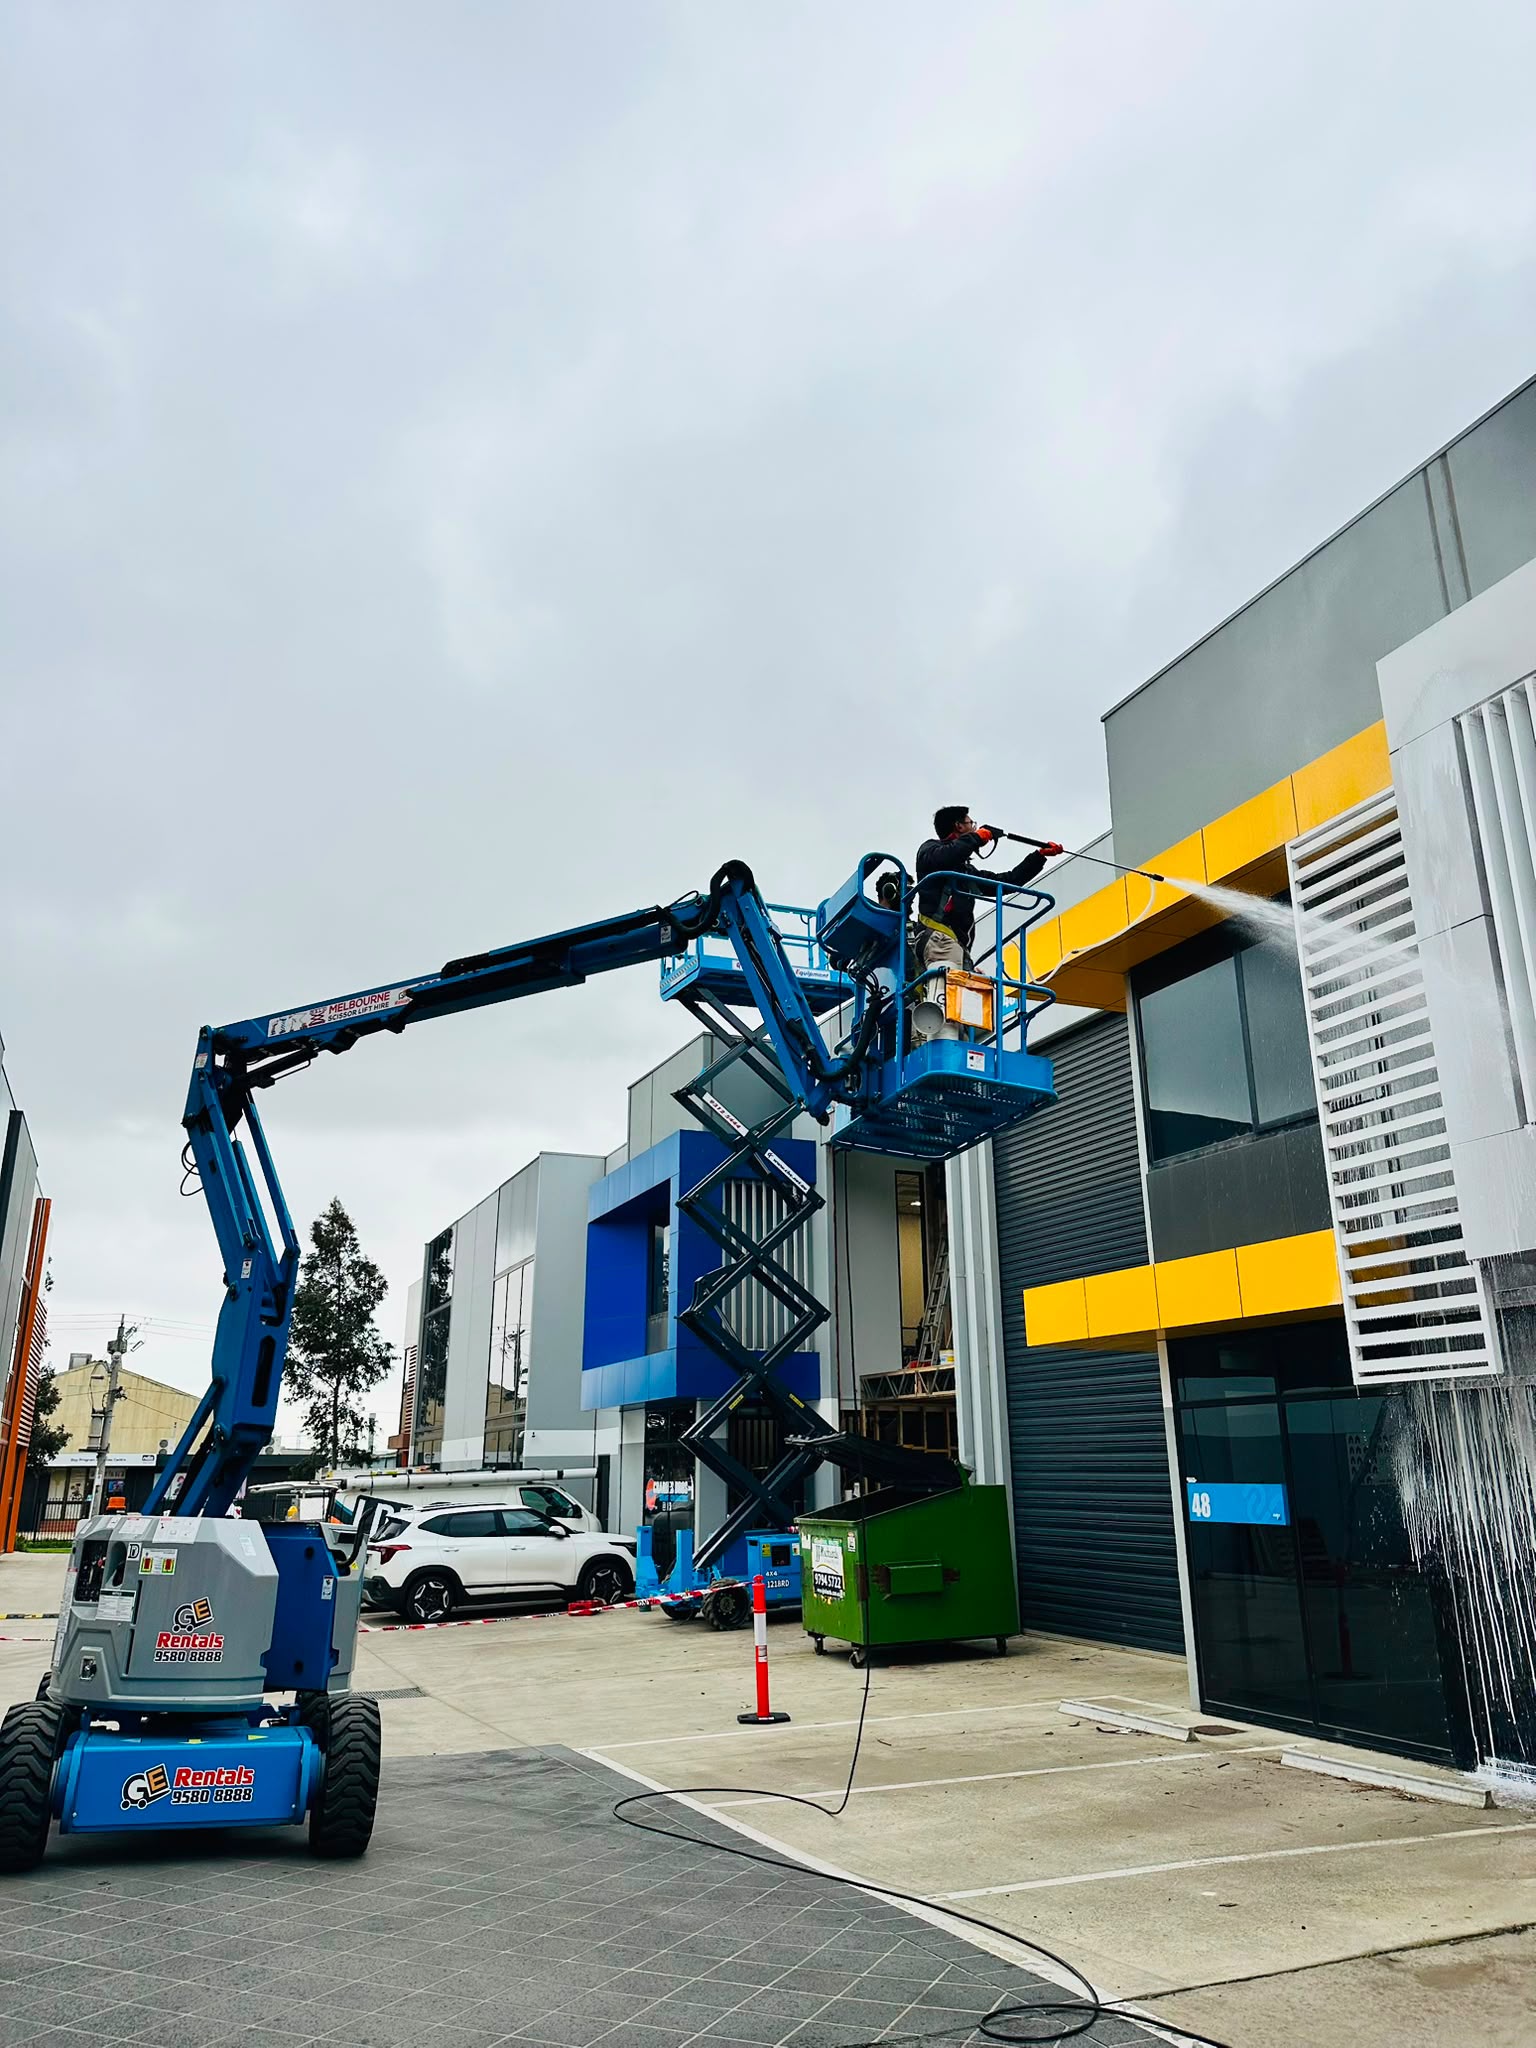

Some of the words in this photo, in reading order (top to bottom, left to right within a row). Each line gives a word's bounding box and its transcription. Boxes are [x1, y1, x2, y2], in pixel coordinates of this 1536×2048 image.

[796, 968, 829, 978] Equipment
[328, 991, 391, 1015] MELBOURNE
[328, 1008, 357, 1022] SCISSOR
[357, 1005, 372, 1017] LIFT
[373, 1001, 390, 1012] HIRE
[1191, 1492, 1211, 1518] 48
[814, 1572, 828, 1587] 9794
[828, 1574, 842, 1589] 5722
[156, 1632, 224, 1648] Rentals
[154, 1650, 187, 1662] 9580
[188, 1650, 223, 1662] 8888
[173, 1766, 254, 1787] Rentals
[171, 1789, 210, 1804] 9580
[213, 1787, 253, 1803] 8888
